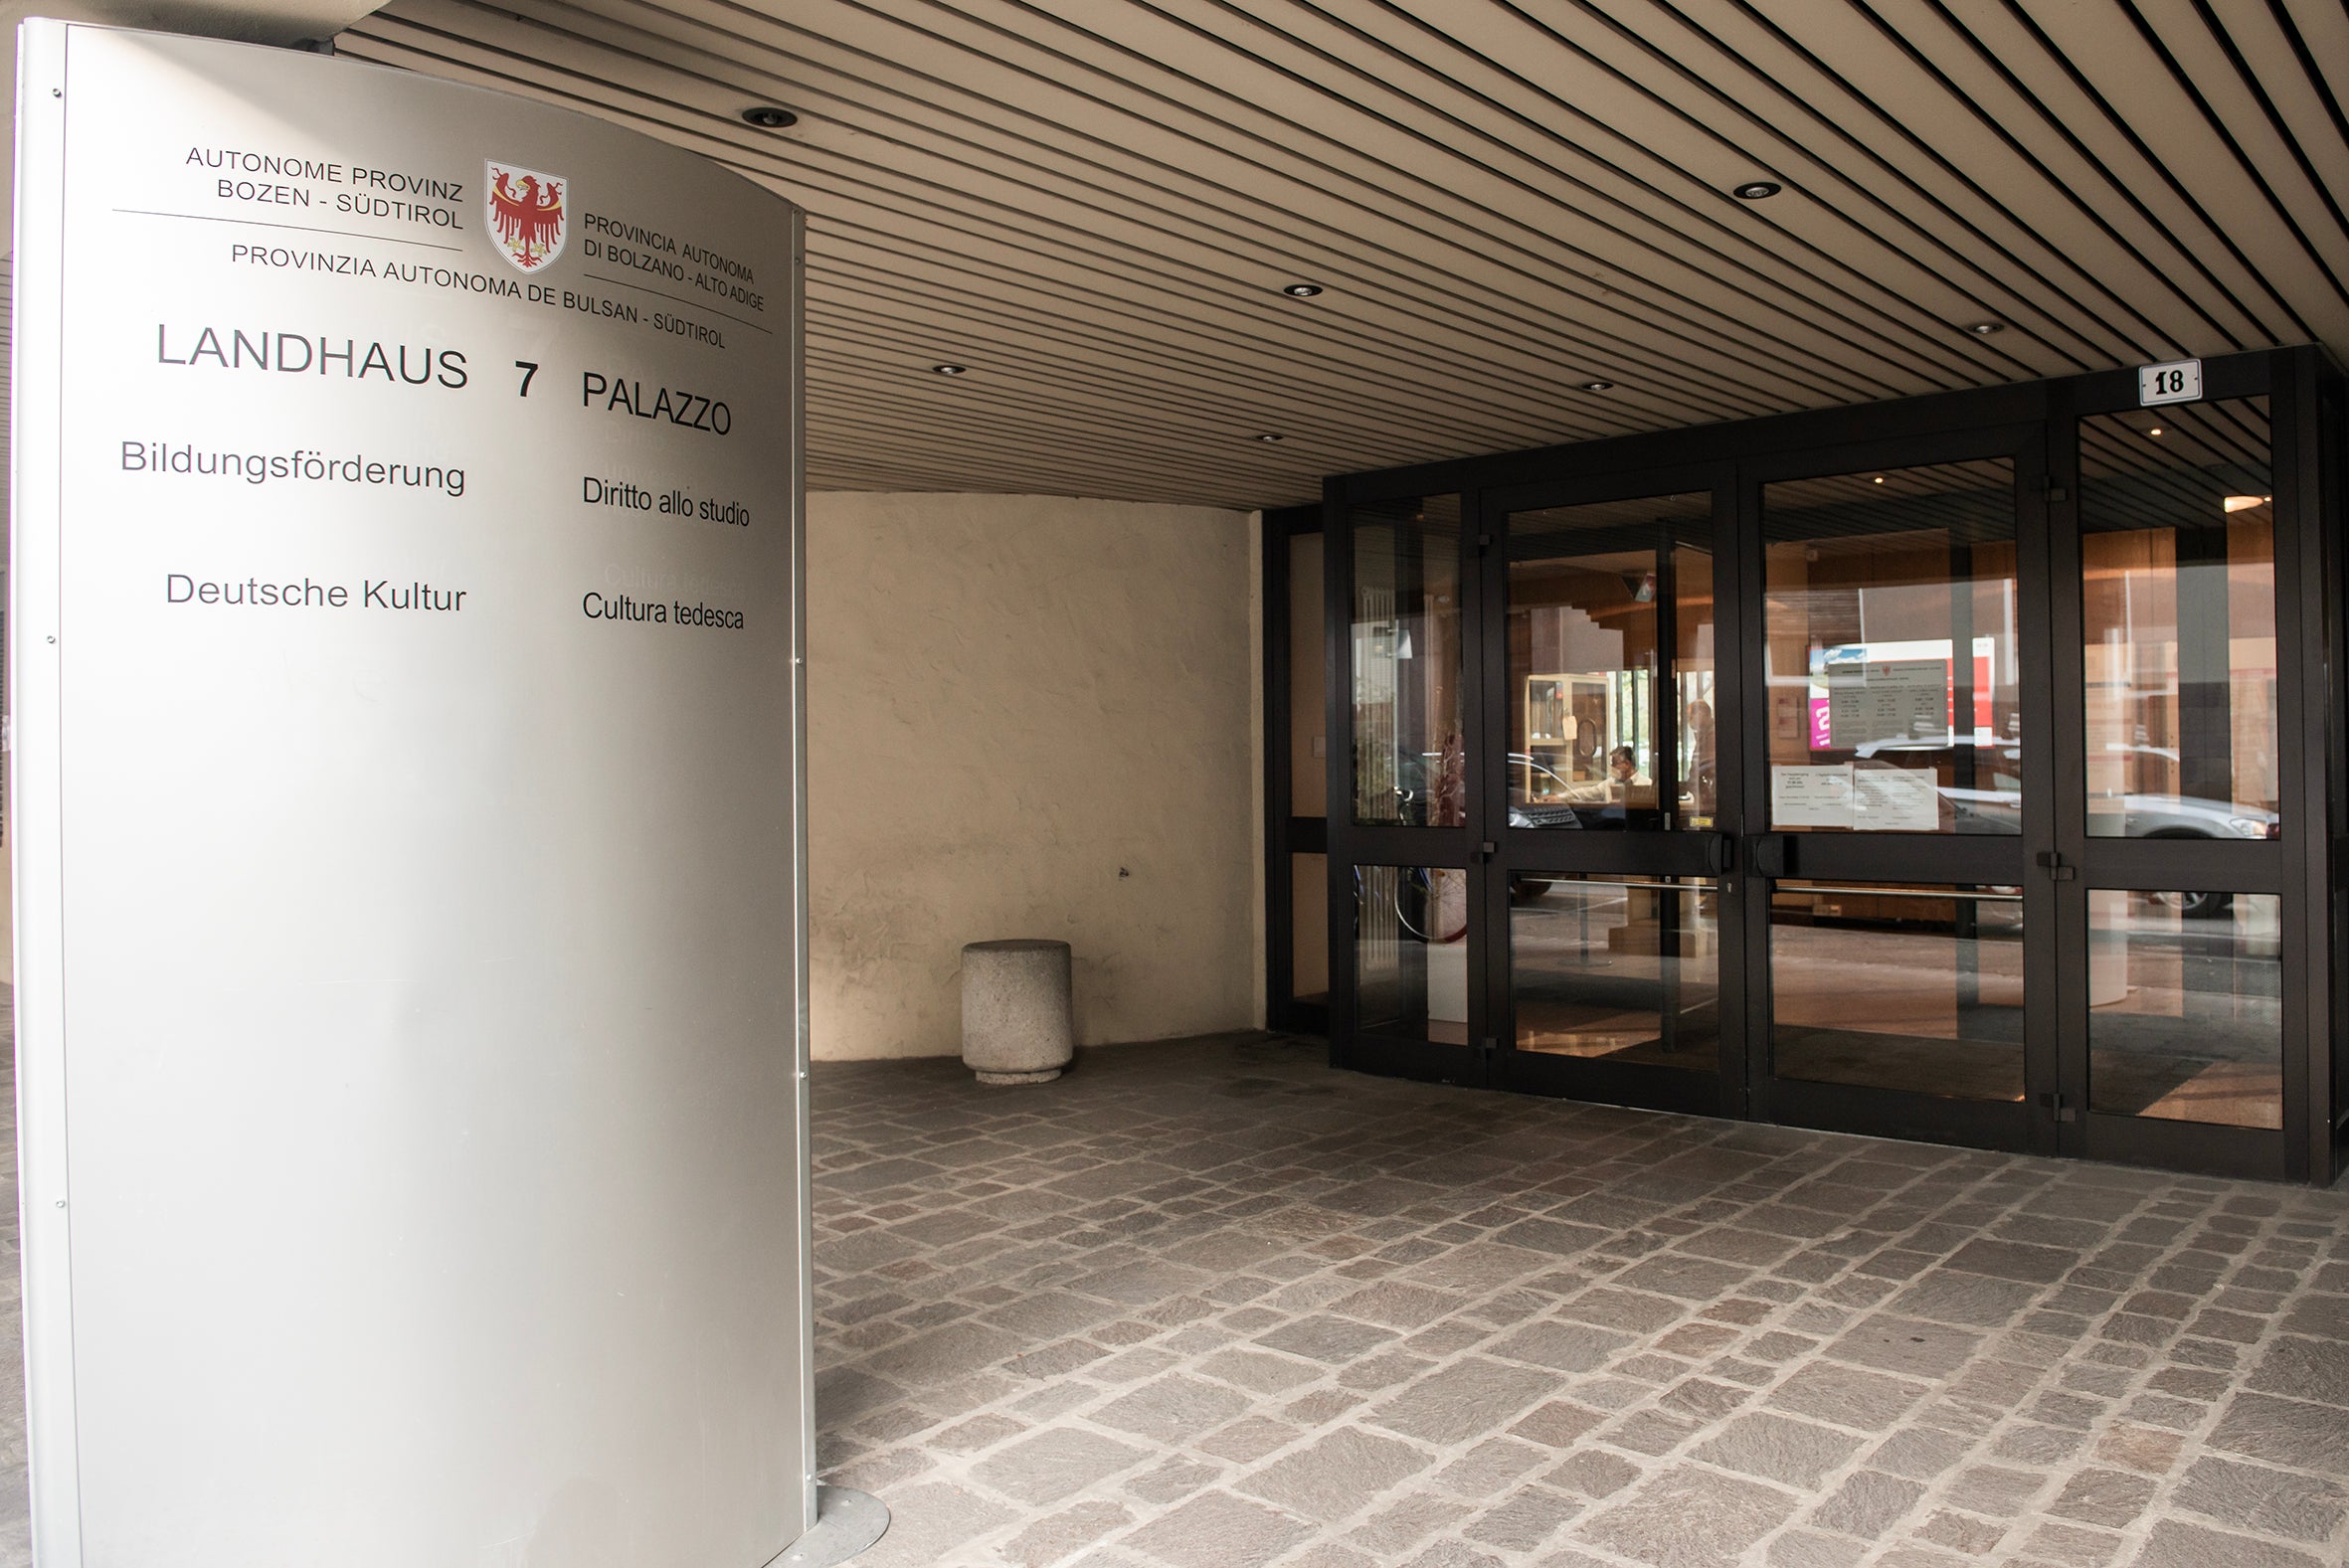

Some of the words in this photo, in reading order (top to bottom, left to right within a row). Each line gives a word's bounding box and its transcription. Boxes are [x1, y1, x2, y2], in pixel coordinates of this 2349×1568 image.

[186, 147, 342, 183] AUTONOME
[352, 167, 463, 202] PROVINZ
[218, 179, 309, 207] BOZEN
[336, 193, 463, 230] SÜDTIROL
[585, 213, 676, 255] PROVINCIA
[682, 244, 754, 284] AUTONOMA
[585, 239, 602, 259] DI
[608, 245, 684, 281] BOLZANO
[695, 272, 727, 297] ALTO
[730, 285, 765, 312] ADIGE
[232, 244, 376, 277] PROVINZIA
[383, 261, 521, 298] AUTONOMA
[528, 284, 556, 305] DE
[564, 291, 637, 324] BULSAN
[653, 313, 726, 349] SÜDTIROL
[158, 324, 468, 389] LANDHAUS
[515, 361, 539, 397] 7
[584, 372, 731, 436] PALAZZO
[2155, 370, 2184, 395] 18
[121, 440, 464, 497] Bildungsförderung
[583, 476, 652, 510] Diritto
[658, 489, 693, 517] allo
[699, 498, 750, 527] studio
[167, 574, 348, 608] Deutsche
[364, 580, 466, 610] Kultur
[583, 592, 667, 623] Cultura
[674, 601, 744, 629] tedesca
